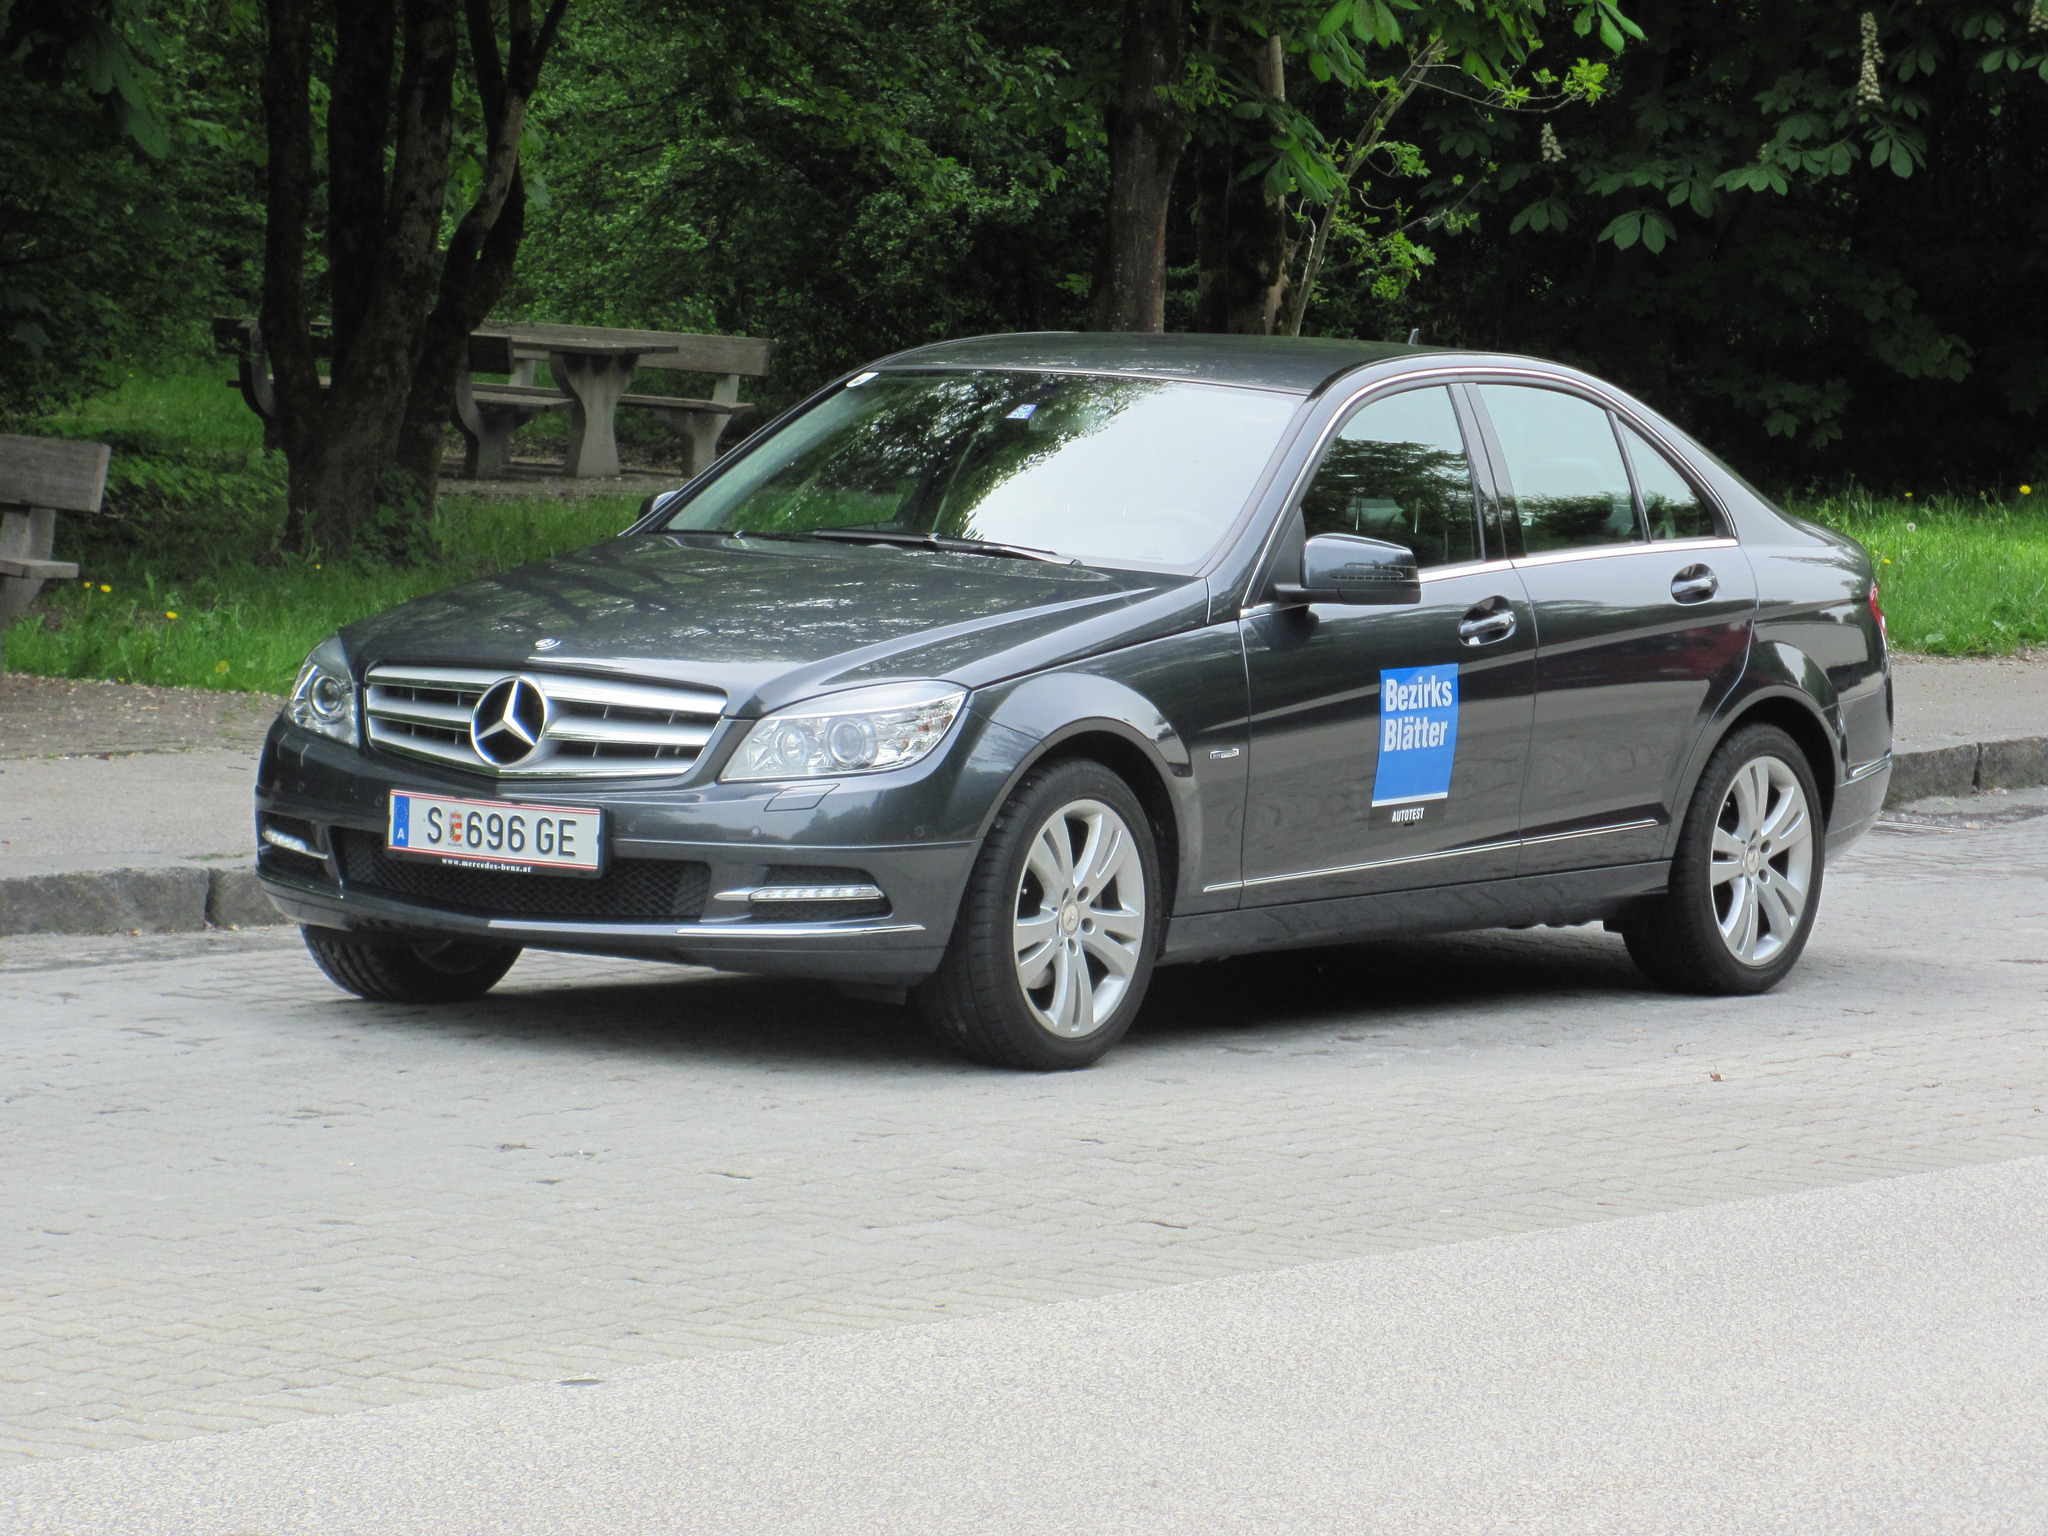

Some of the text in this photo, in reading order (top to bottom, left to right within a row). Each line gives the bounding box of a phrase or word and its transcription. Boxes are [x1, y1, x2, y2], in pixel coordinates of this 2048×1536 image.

[1385, 675, 1453, 712] Bezirks
[1383, 716, 1448, 752] Blätter
[1391, 807, 1425, 823] AUTOTEST
[397, 829, 404, 839] A
[427, 806, 577, 857] S 696 GE
[442, 857, 532, 873] www.mercedes-benz.at
